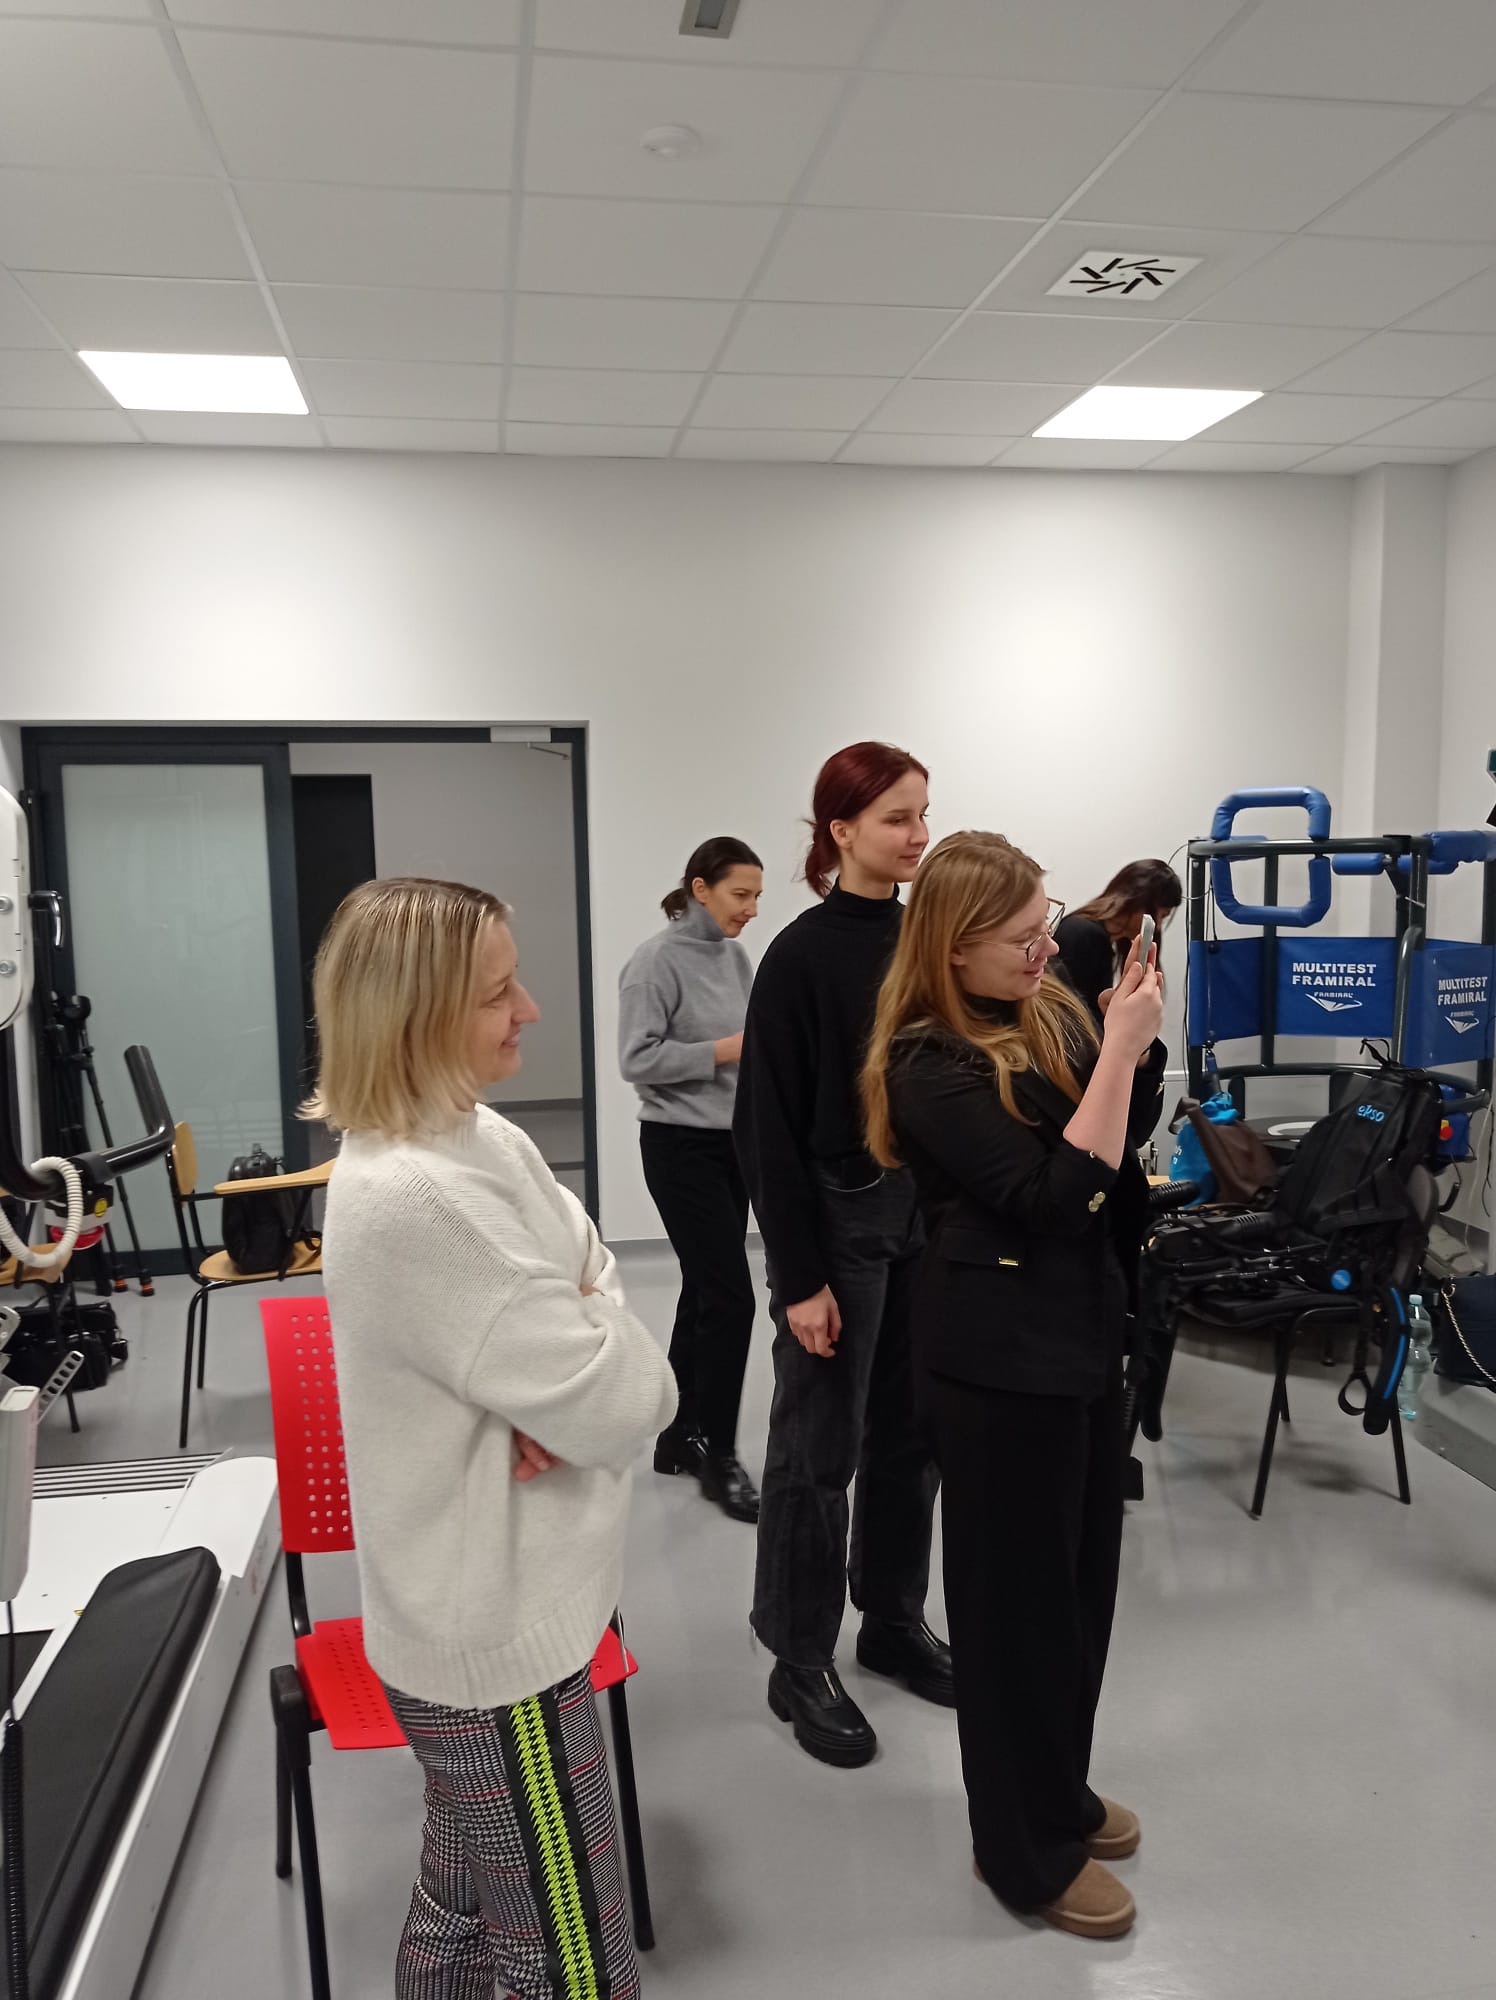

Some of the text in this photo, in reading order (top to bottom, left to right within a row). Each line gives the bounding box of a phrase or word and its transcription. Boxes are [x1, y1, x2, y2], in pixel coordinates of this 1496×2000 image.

[1292, 962, 1377, 974] MULTITEST
[1292, 975, 1376, 987] FRAMIRAL
[1438, 976, 1488, 991] MULTITEST
[1437, 991, 1487, 1006] FRAMIRAL
